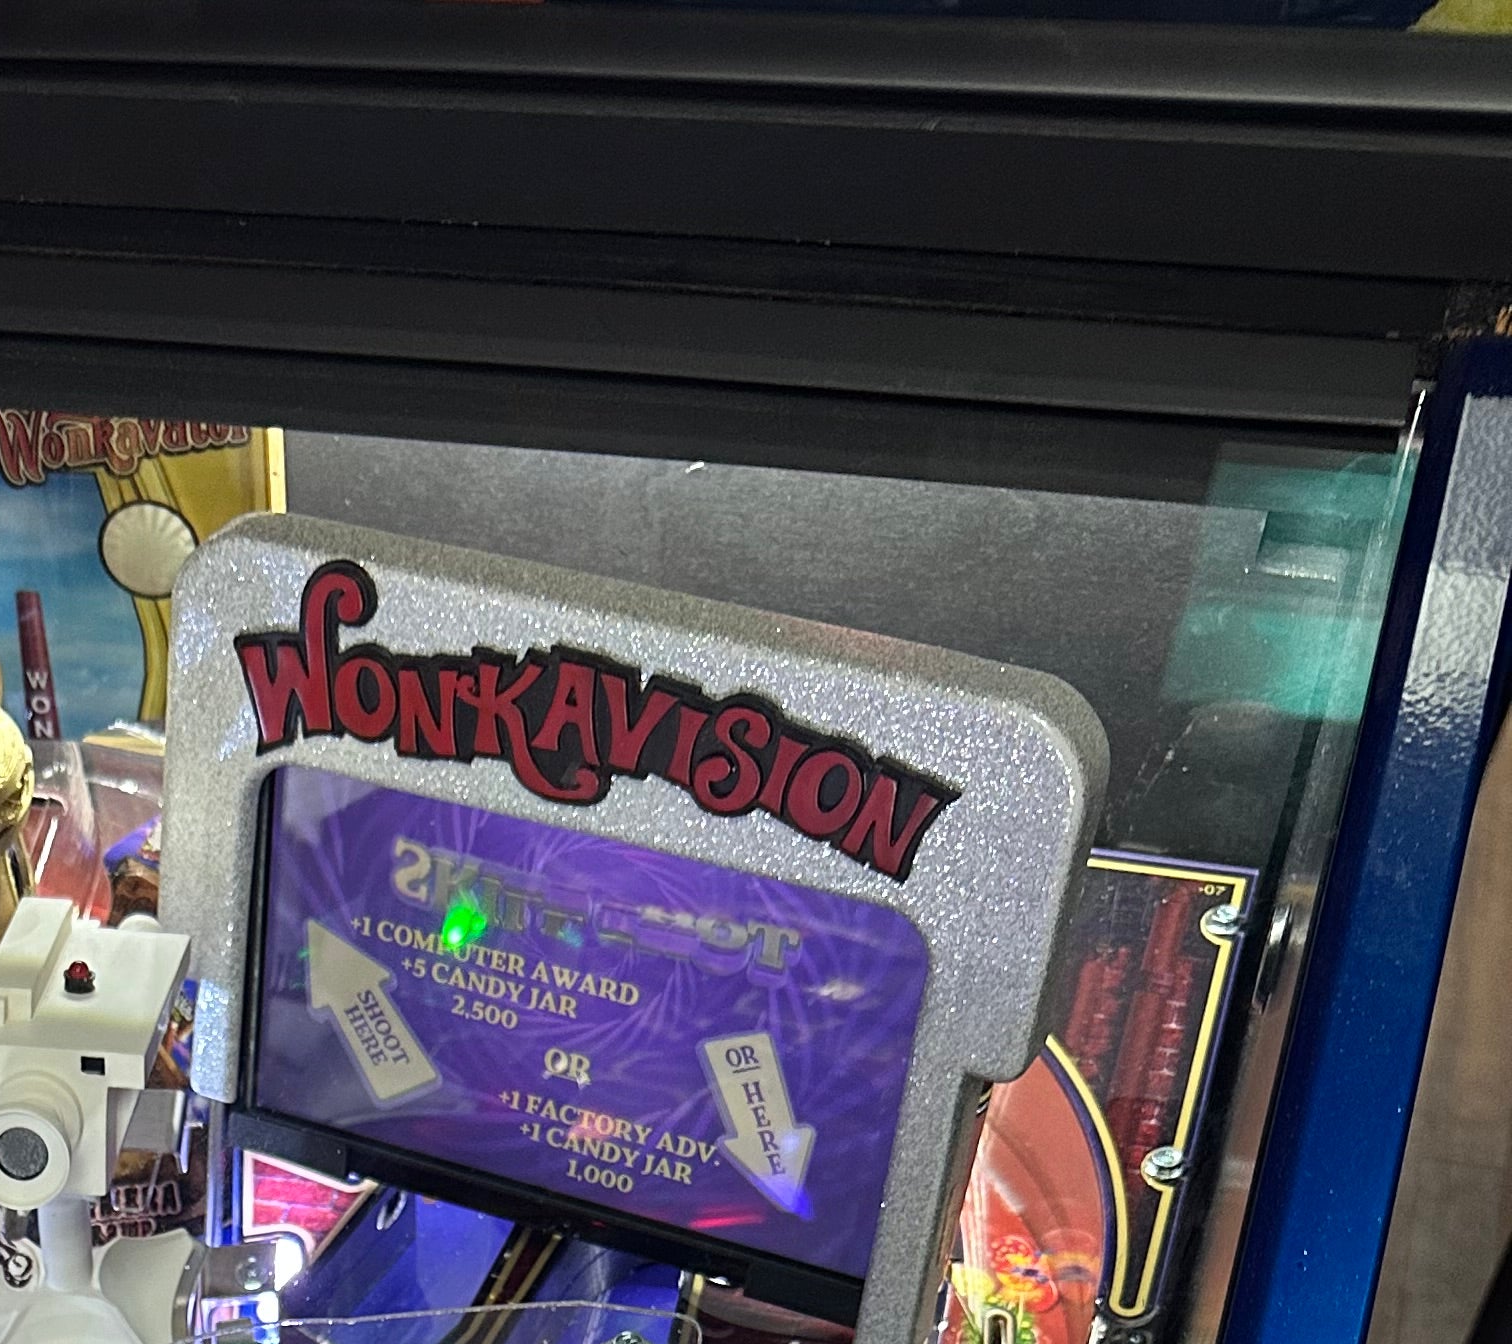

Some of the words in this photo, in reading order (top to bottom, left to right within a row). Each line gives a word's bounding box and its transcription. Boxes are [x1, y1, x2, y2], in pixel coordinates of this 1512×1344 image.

[25, 669, 56, 739] WON
[235, 559, 962, 882] WONKAVISION
[376, 919, 526, 977] COMPUTER
[530, 959, 640, 1007] AWARD
[401, 957, 426, 978] +5
[431, 963, 522, 1004] CANDY
[523, 988, 578, 1019] JAR
[346, 1003, 389, 1069] HERE
[356, 987, 411, 1067] SHOOT
[450, 995, 518, 1030] 2,500
[543, 1046, 592, 1085] OR
[724, 1044, 760, 1071] OR
[498, 1089, 522, 1111] +1
[523, 1094, 651, 1146] FACTORY
[654, 1129, 720, 1168] ADV.
[519, 1120, 543, 1143] +1
[546, 1126, 637, 1171] CANDY
[637, 1152, 693, 1187] JAR
[744, 1081, 785, 1176] HERE
[565, 1157, 633, 1194] 1,000
